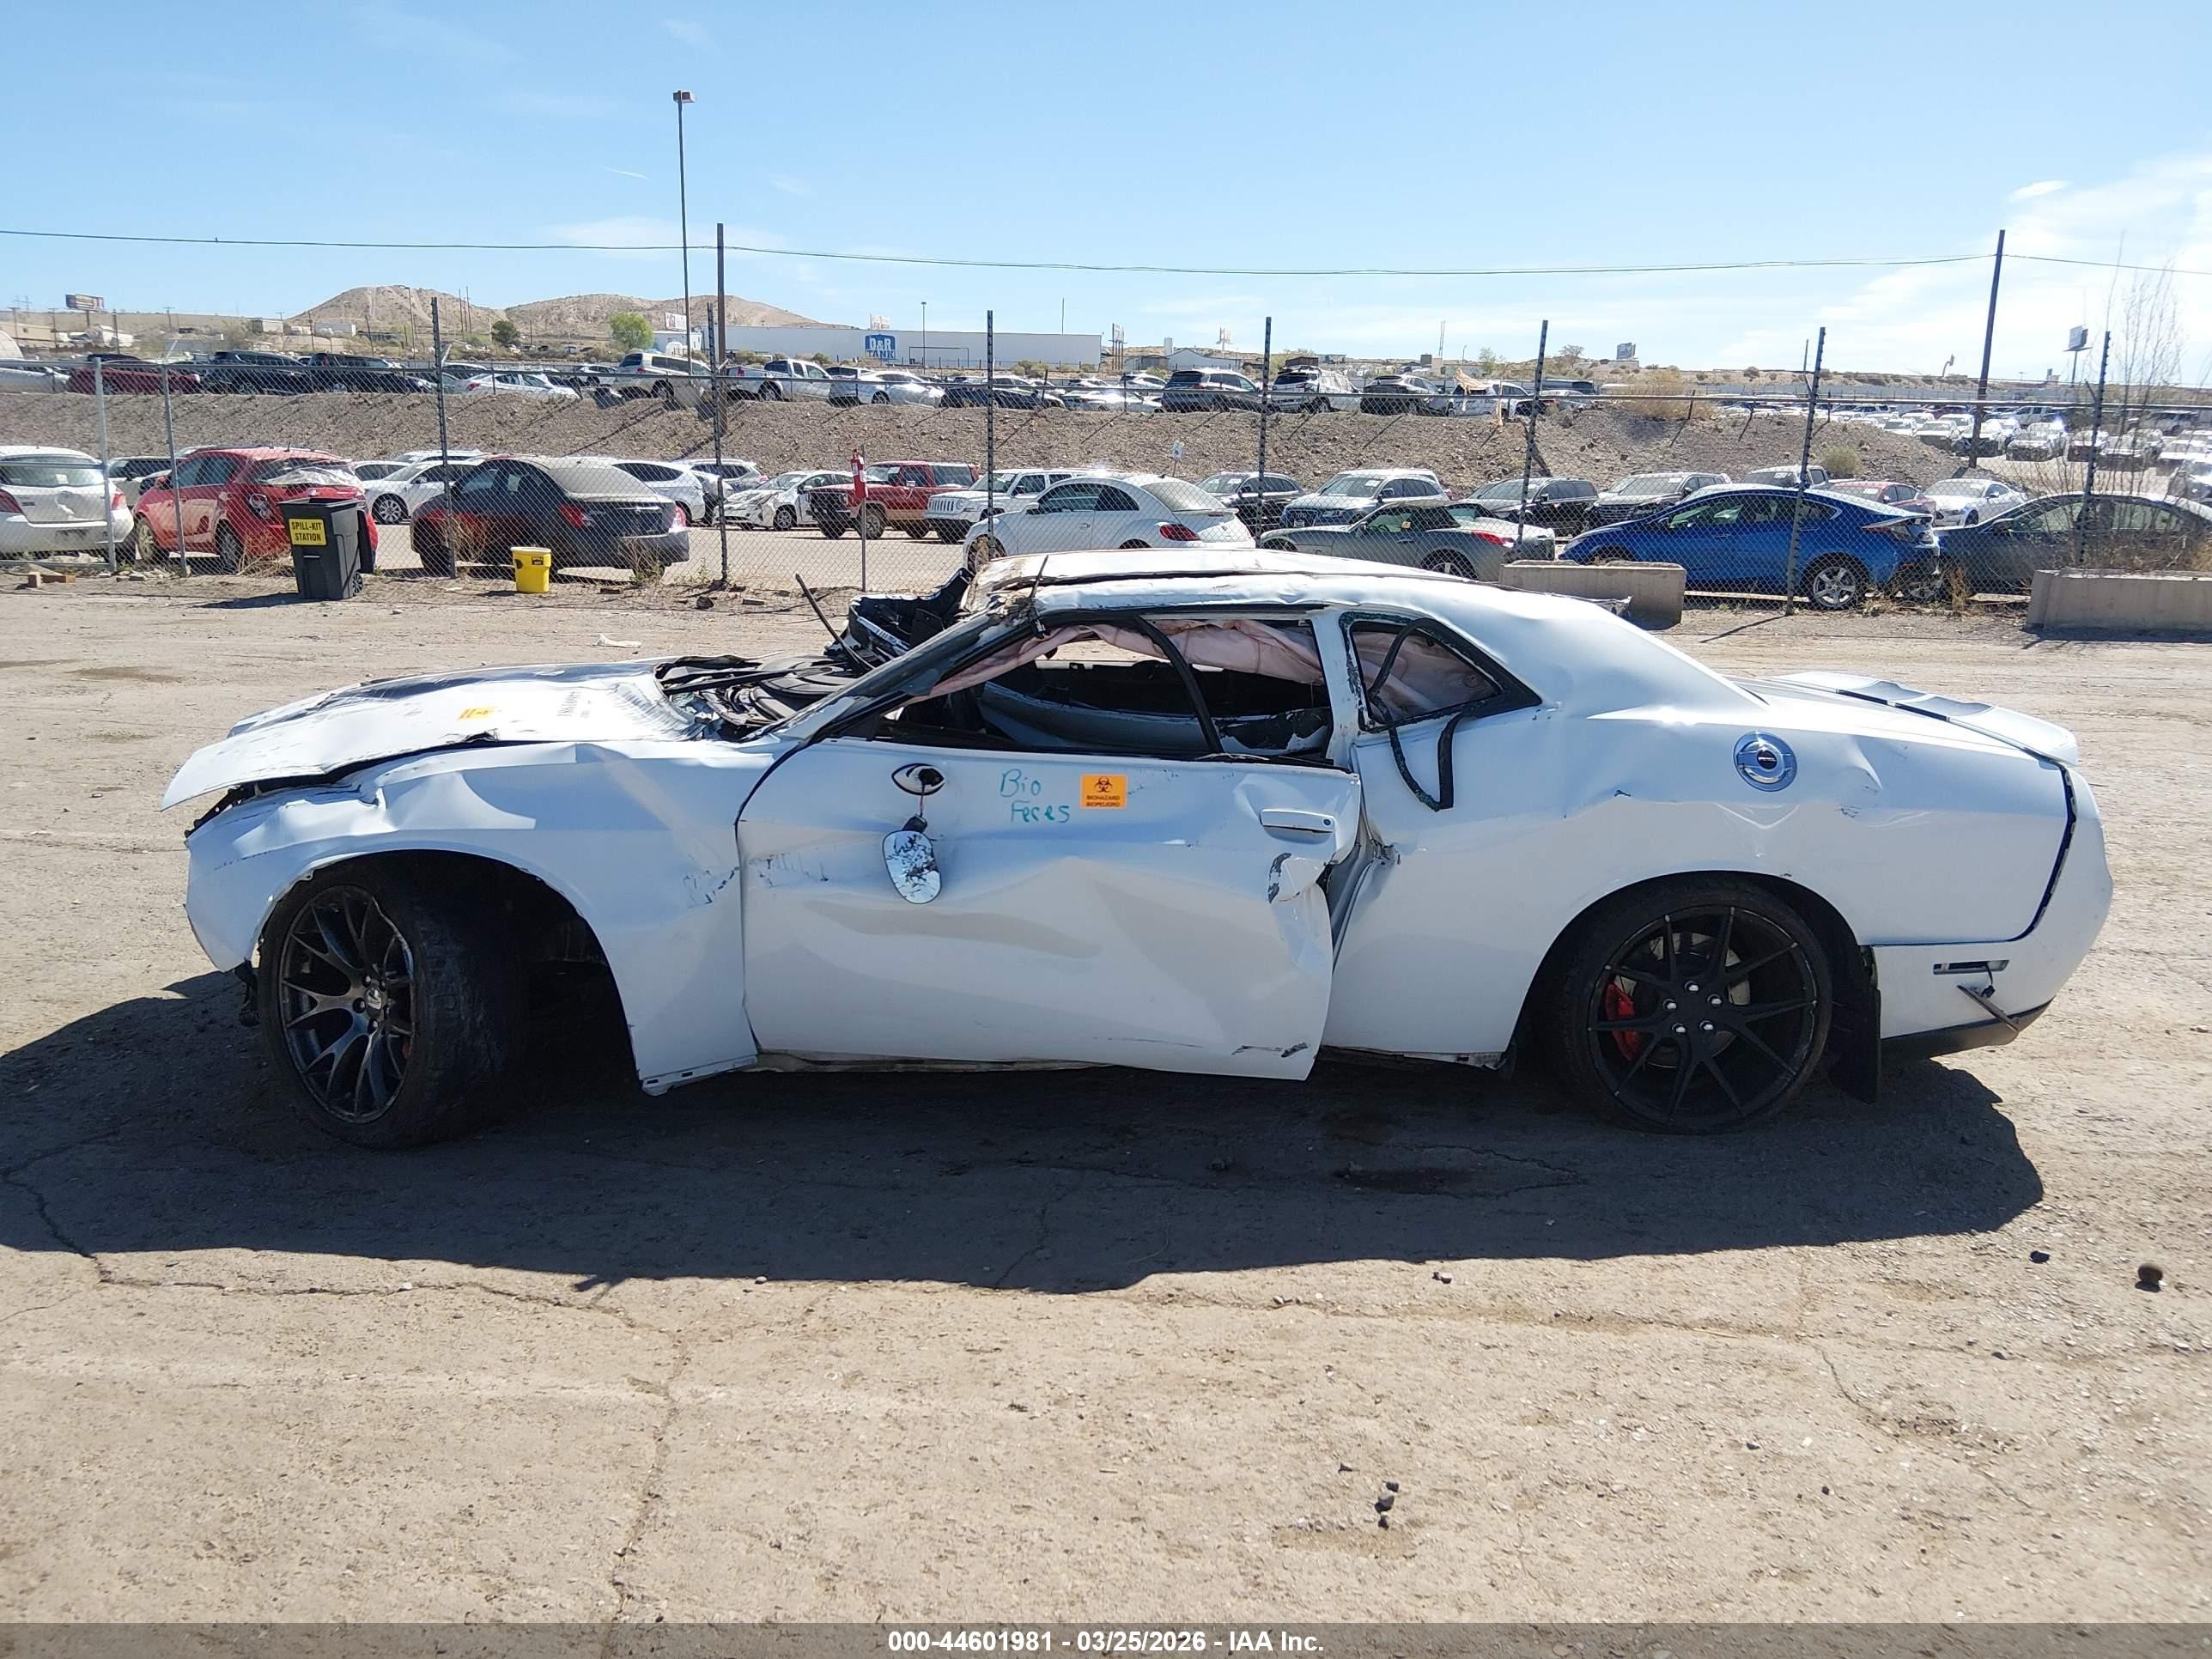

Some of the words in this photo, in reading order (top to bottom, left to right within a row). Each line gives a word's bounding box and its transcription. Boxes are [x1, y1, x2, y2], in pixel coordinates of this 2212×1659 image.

[869, 337, 892, 350] D&R
[866, 349, 894, 358] TANK
[291, 521, 322, 530] SPILL-KIT
[295, 532, 321, 541] STATION
[1000, 769, 1042, 798] Bio
[1010, 799, 1071, 824] Feces
